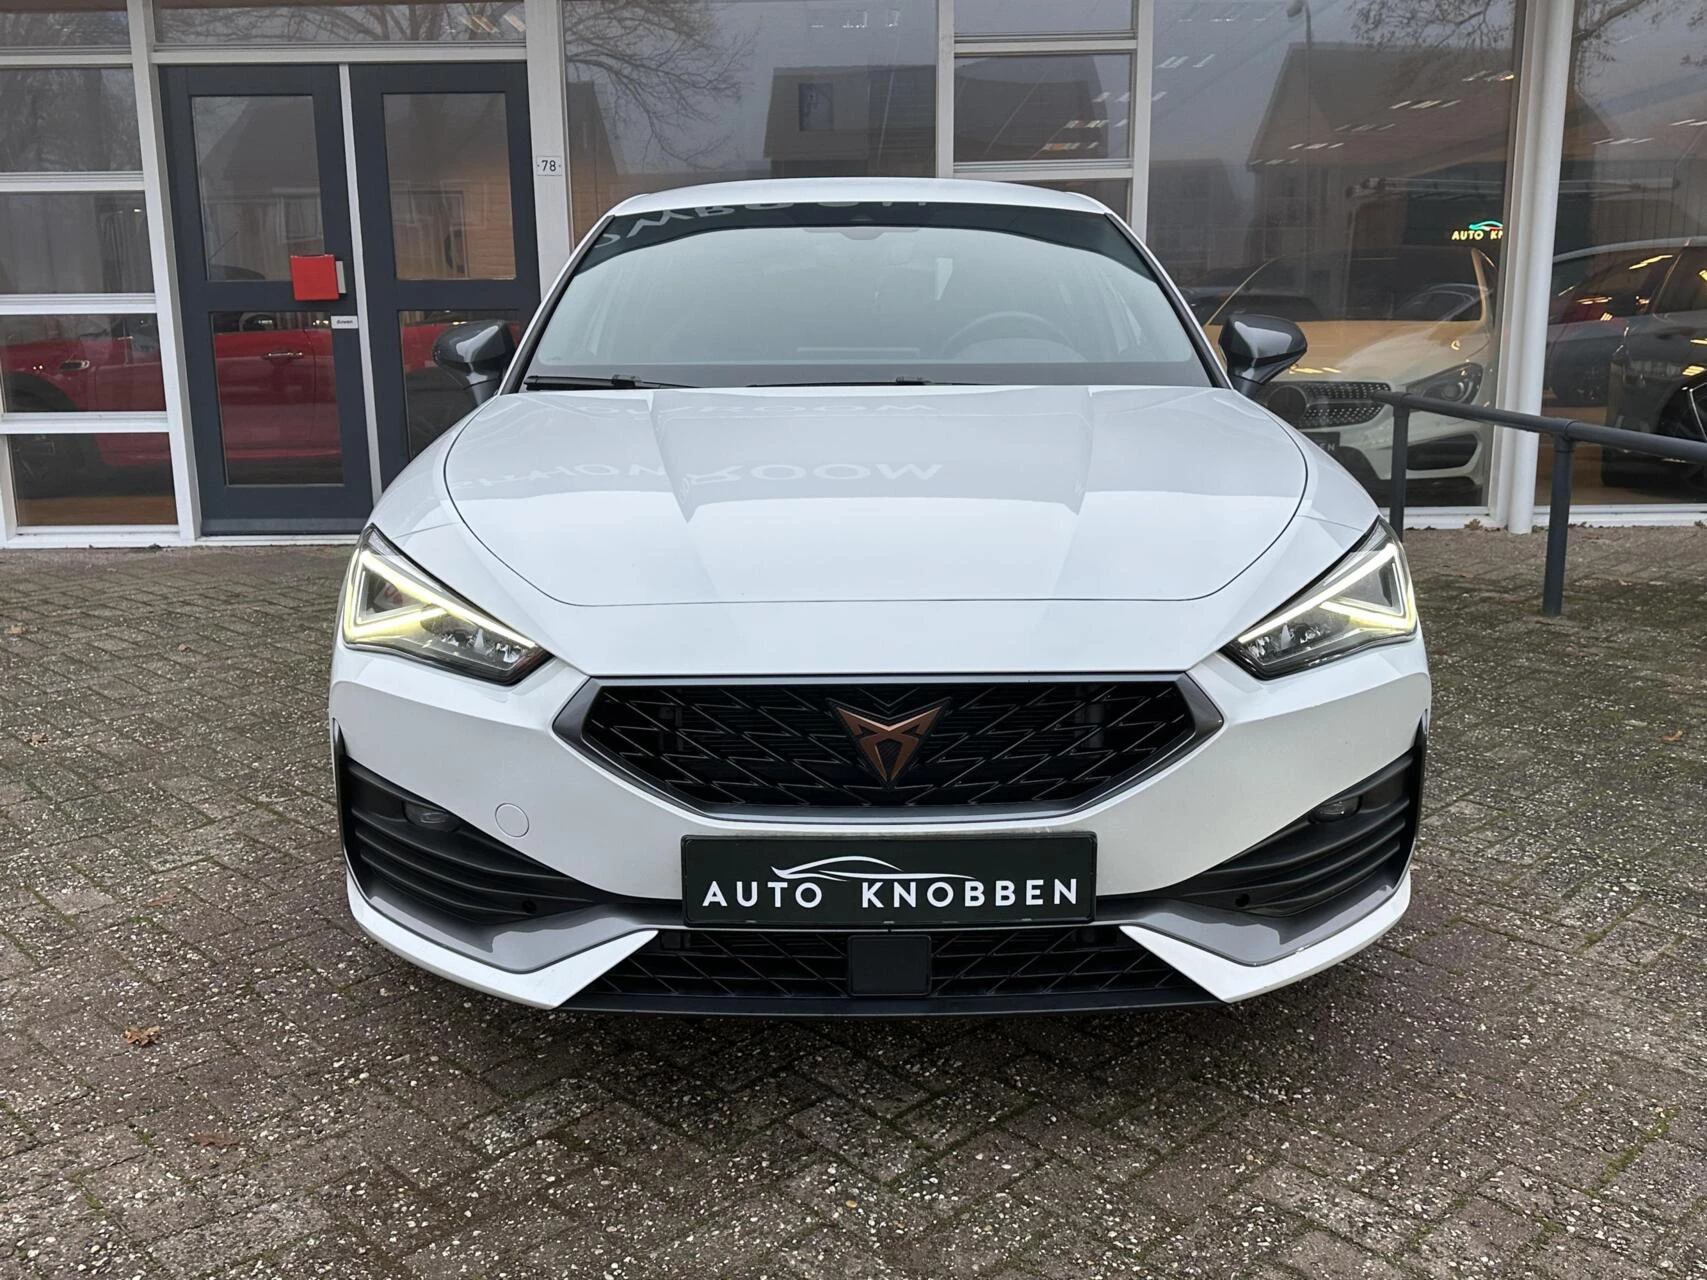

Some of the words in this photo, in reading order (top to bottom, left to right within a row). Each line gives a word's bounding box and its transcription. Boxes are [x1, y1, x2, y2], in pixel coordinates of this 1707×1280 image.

[541, 160, 557, 172] 78
[1451, 230, 1484, 240] AUTO
[702, 880, 823, 908] AUTO
[861, 878, 1078, 909] KNOBBEN
